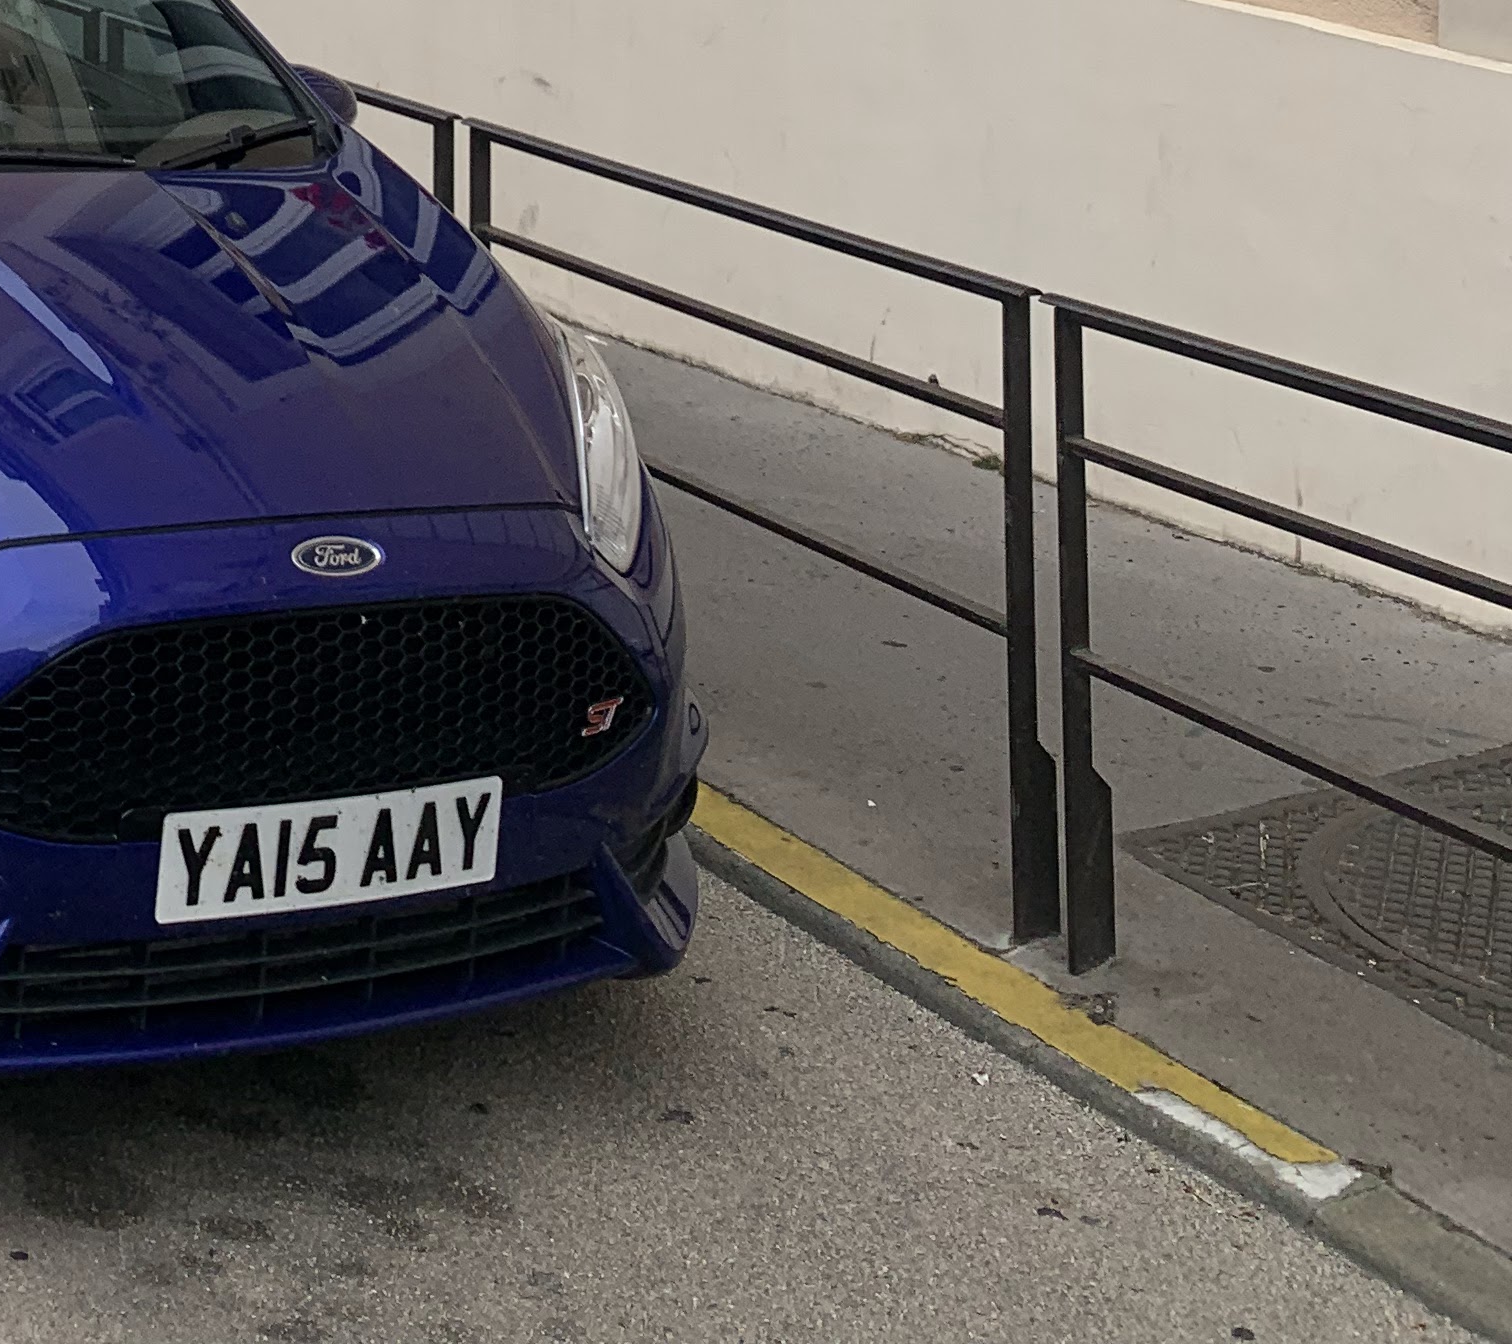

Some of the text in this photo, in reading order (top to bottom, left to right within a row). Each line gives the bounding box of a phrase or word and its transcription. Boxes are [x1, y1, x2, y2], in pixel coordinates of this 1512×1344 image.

[314, 544, 362, 567] Ford
[178, 793, 492, 906] YA15 AAY
